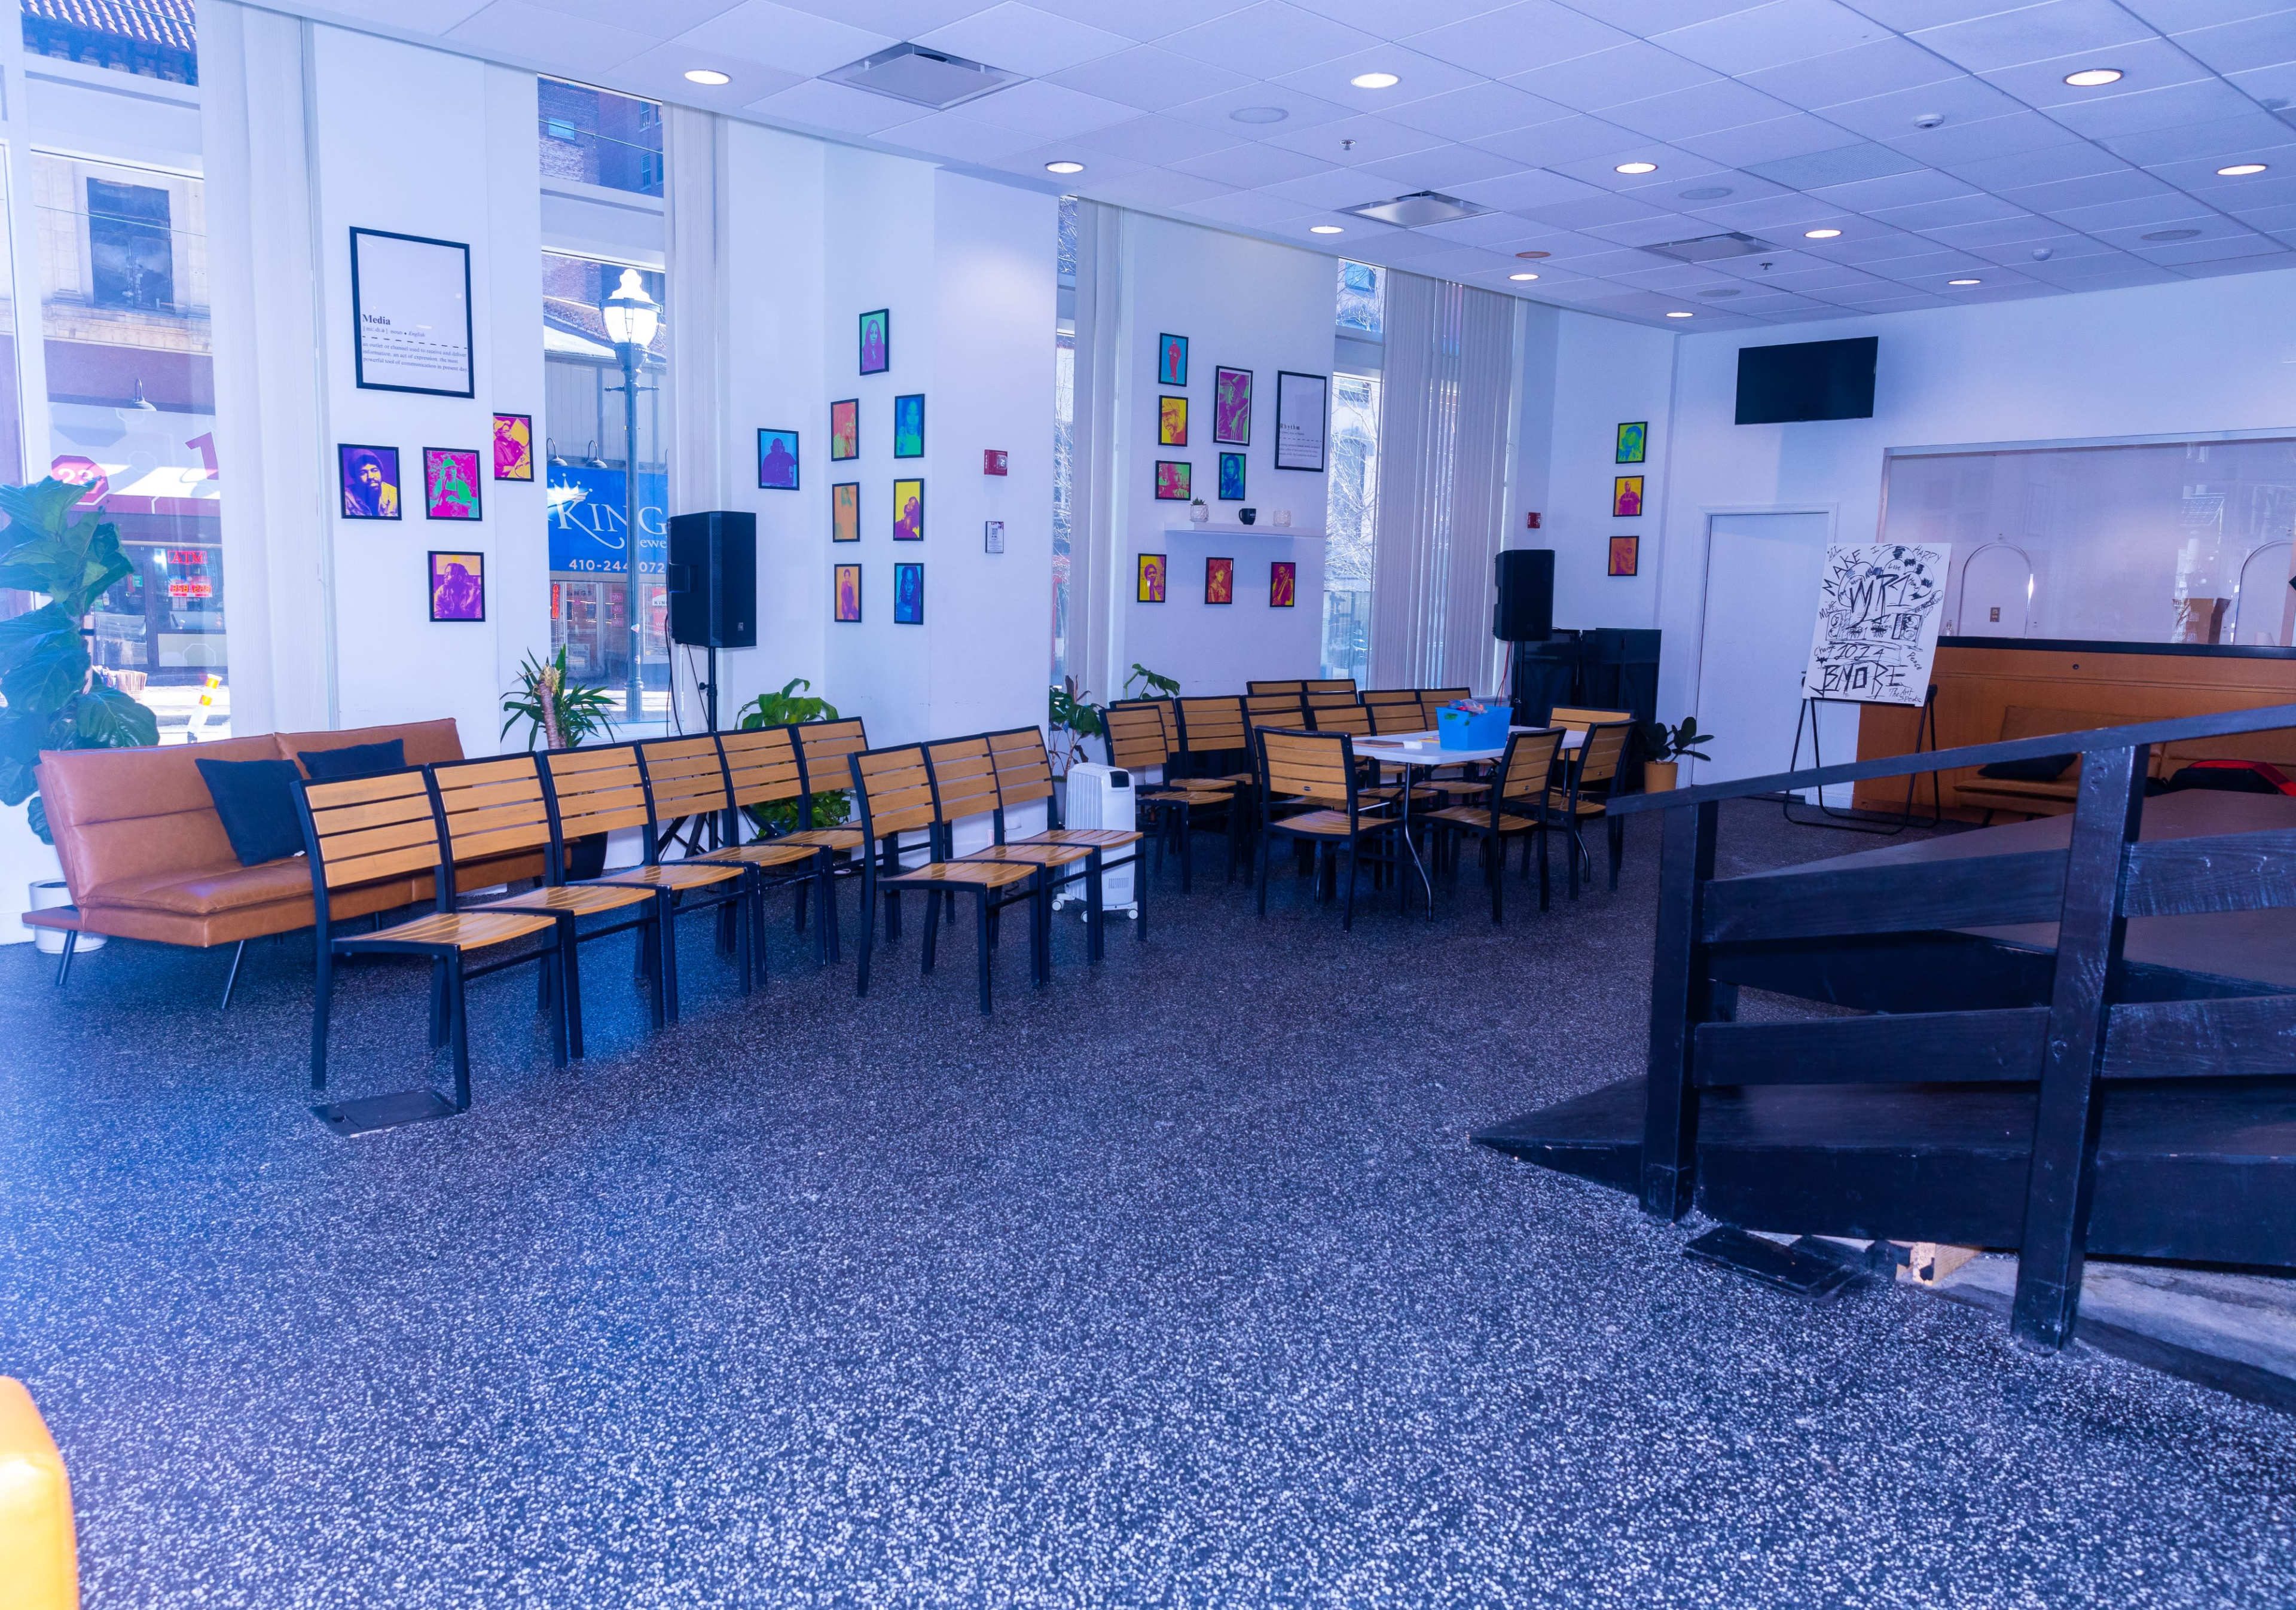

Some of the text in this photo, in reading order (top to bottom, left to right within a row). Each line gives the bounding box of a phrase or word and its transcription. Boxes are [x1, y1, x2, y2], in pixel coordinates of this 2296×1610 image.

[362, 313, 390, 325] Media
[171, 551, 203, 564] ATM
[1913, 545, 1942, 564] HAPPY
[1822, 549, 1861, 597] MAKE
[1907, 652, 1922, 671] Peace
